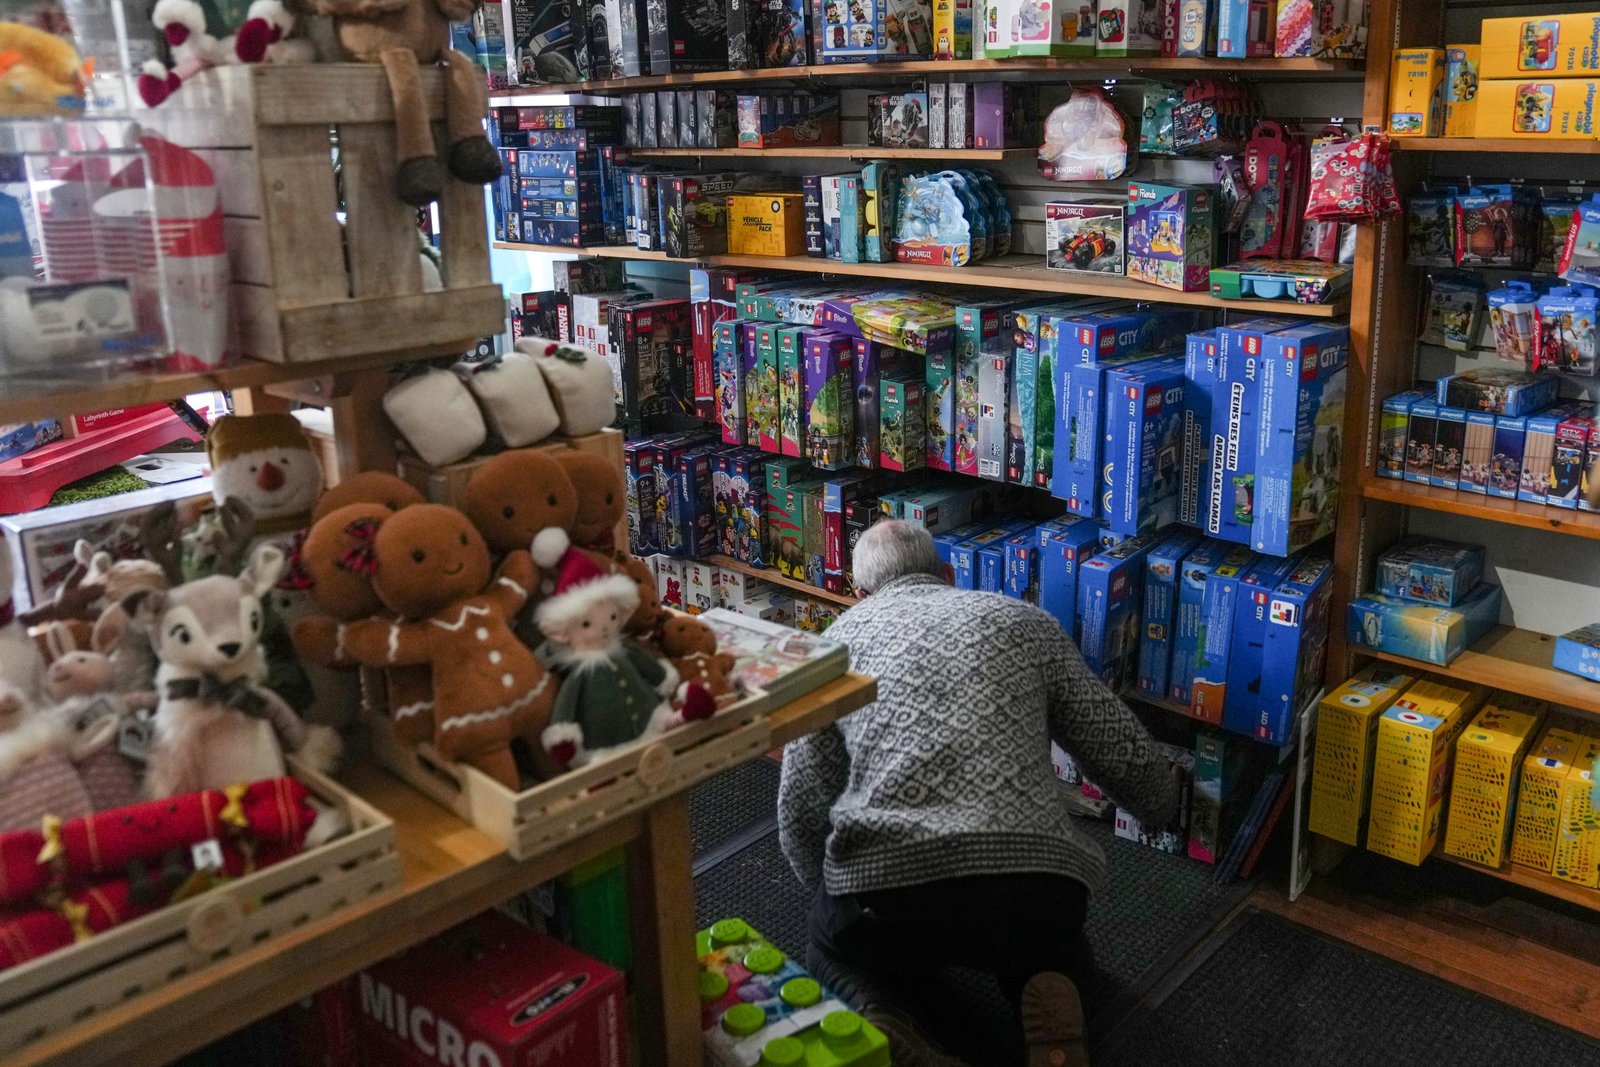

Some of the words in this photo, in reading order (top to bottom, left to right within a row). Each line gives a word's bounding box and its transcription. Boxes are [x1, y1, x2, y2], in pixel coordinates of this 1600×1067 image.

[1181, 103, 1202, 114] DOTS
[1584, 83, 1596, 135] playmobil
[702, 180, 734, 191] SPEED
[1056, 206, 1086, 217] NINJAGO
[906, 249, 932, 259] NINJAGO
[1544, 305, 1575, 313] playmobil
[558, 304, 569, 343] MARVEL
[984, 320, 999, 330] LEGO
[1101, 336, 1116, 347] LEGO
[1118, 329, 1138, 346] CITY
[1081, 348, 1090, 364] CIT
[1320, 346, 1340, 368] CITY
[1022, 353, 1033, 376] WISH
[1245, 358, 1256, 382] CITY
[1285, 362, 1293, 377] CITY
[1146, 394, 1162, 409] LEGO
[1165, 386, 1184, 404] CITY
[1232, 384, 1243, 419] ÉTEINS
[1300, 388, 1310, 402] 6+
[83, 411, 109, 423] Labyrinth
[109, 408, 125, 417] Game
[1128, 401, 1136, 417] CITY
[1413, 406, 1436, 415] playmobil
[1440, 410, 1464, 419] playmobil
[1469, 414, 1495, 423] playmobil
[1499, 418, 1524, 427] playmobil
[1530, 422, 1555, 431] playmobil
[1230, 422, 1239, 441] DES
[1560, 427, 1580, 436] CITY
[1215, 436, 1224, 469] APAGA
[1228, 443, 1237, 469] FEUX
[1213, 472, 1221, 490] LAS
[1190, 491, 1198, 522] INCLUSES
[1210, 492, 1220, 531] LLAMAS
[1255, 606, 1264, 621] CITY
[1260, 710, 1269, 726] CITY
[360, 972, 502, 1067] MICRO
